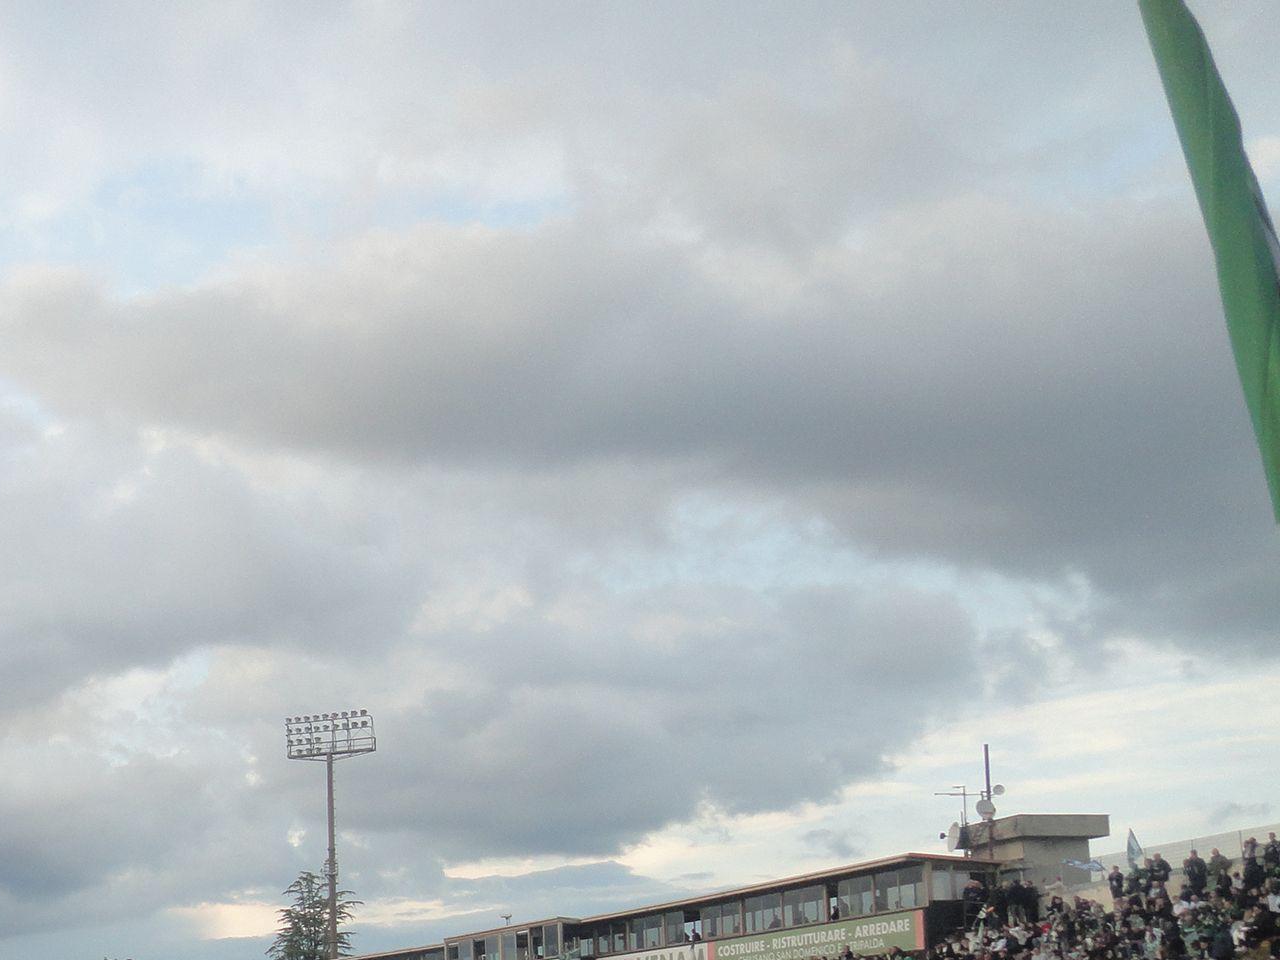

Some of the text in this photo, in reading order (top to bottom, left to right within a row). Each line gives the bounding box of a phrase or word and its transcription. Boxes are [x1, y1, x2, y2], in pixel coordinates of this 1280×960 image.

[718, 939, 765, 957] COSTRUIRE
[772, 928, 846, 949] RISTRUTTURARE
[854, 918, 910, 938] ARREDARE
